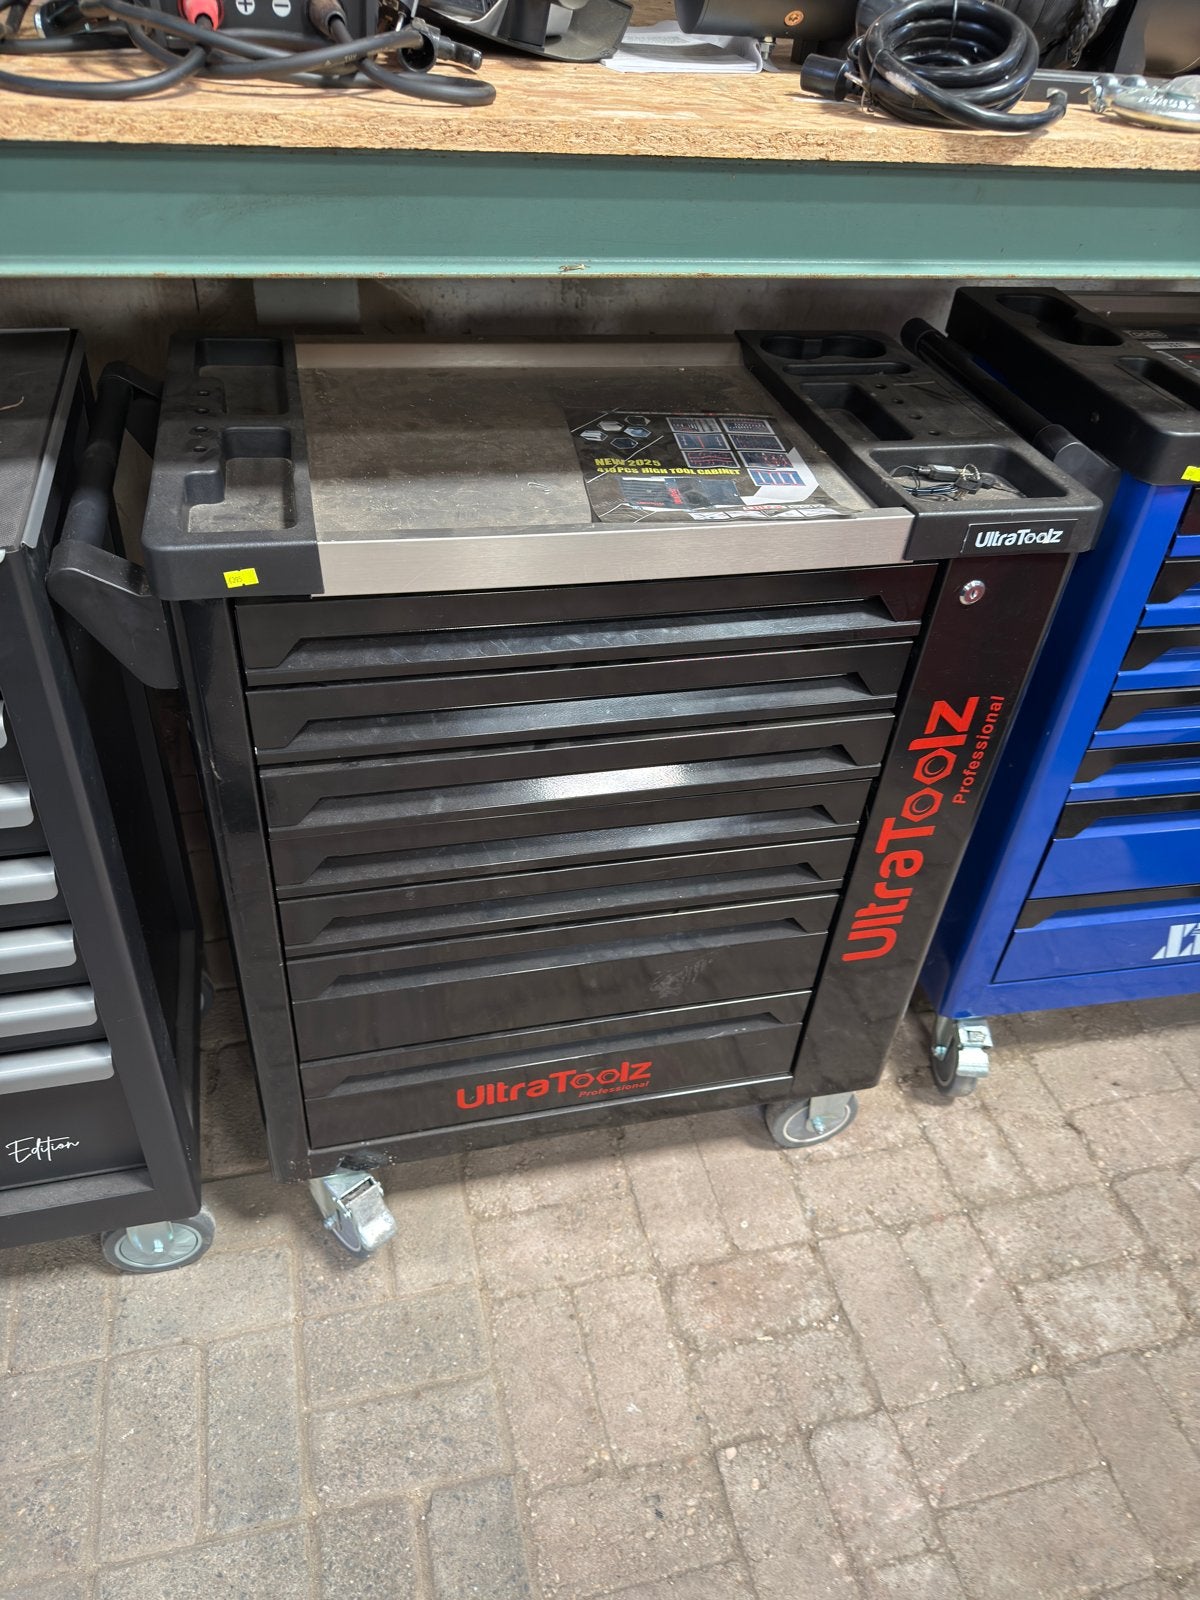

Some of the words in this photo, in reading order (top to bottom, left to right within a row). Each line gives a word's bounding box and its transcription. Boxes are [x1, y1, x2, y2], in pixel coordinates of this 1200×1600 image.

[594, 458, 625, 467] NEW
[627, 458, 661, 467] 2025
[641, 467, 668, 475] HIGH
[975, 528, 1064, 548] UltraToolz
[952, 695, 1005, 805] Professional
[841, 696, 980, 962] UltraToolz
[456, 1061, 654, 1110] UltraToolz
[579, 1081, 650, 1098] Professional
[5, 1136, 80, 1163] Edition
